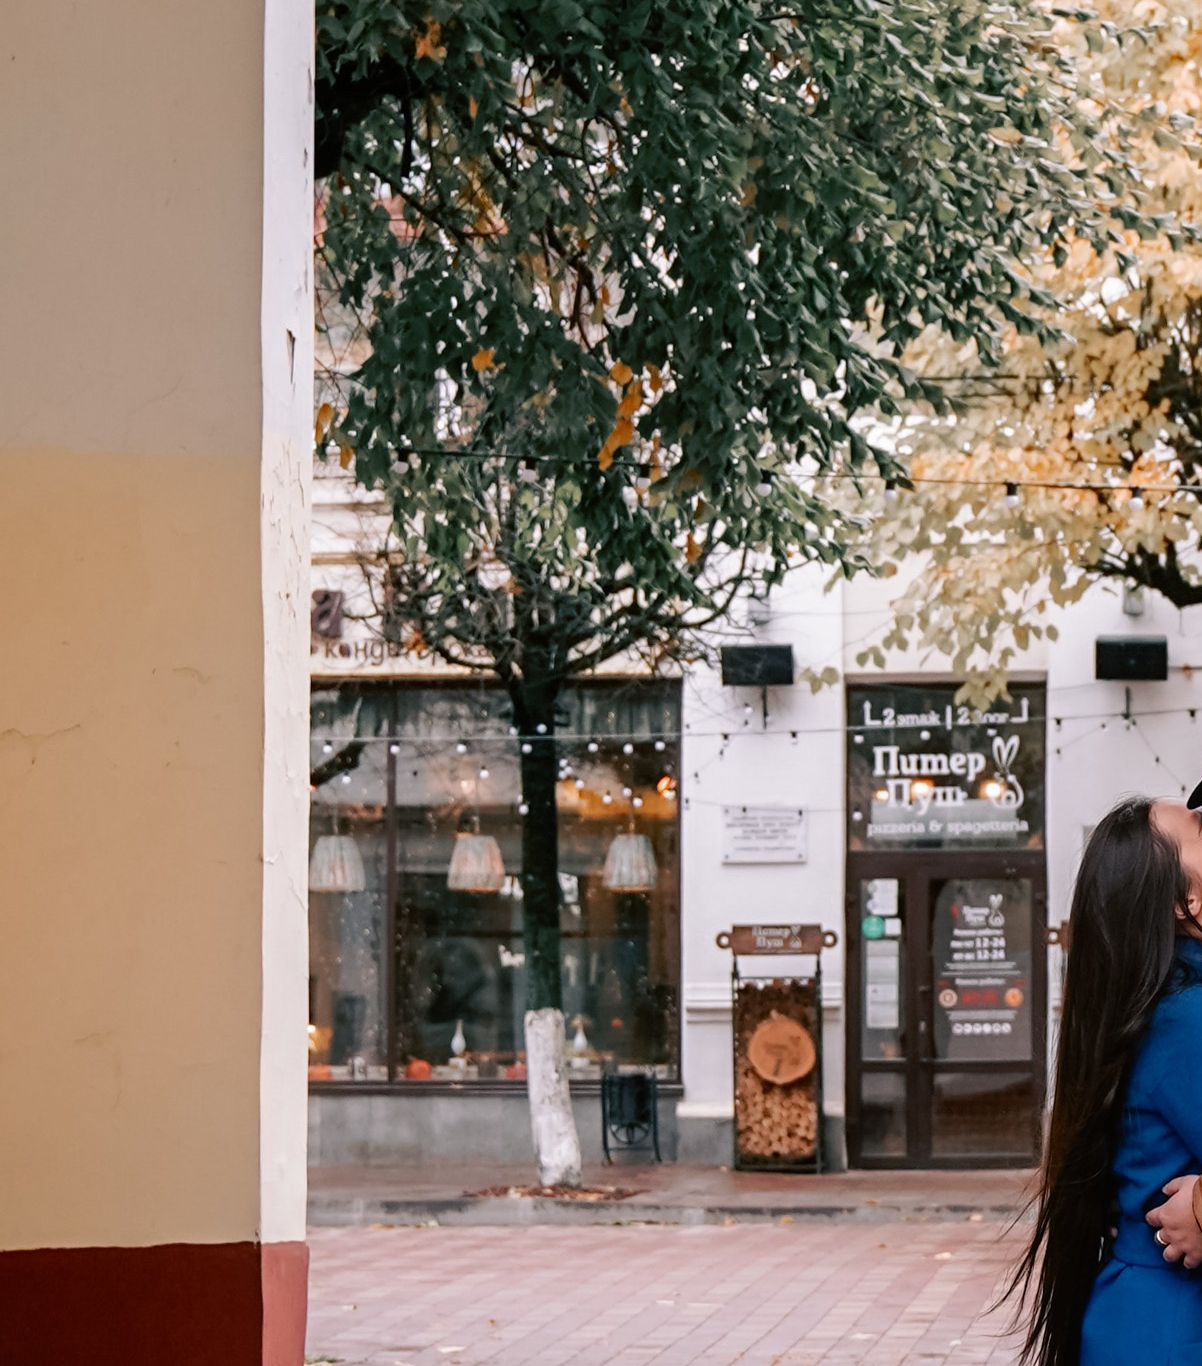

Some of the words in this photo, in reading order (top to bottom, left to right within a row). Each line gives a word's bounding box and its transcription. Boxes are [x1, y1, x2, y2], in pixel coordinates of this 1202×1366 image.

[882, 707, 896, 725] 2
[957, 706, 971, 725] 2
[873, 746, 986, 782] Питер
